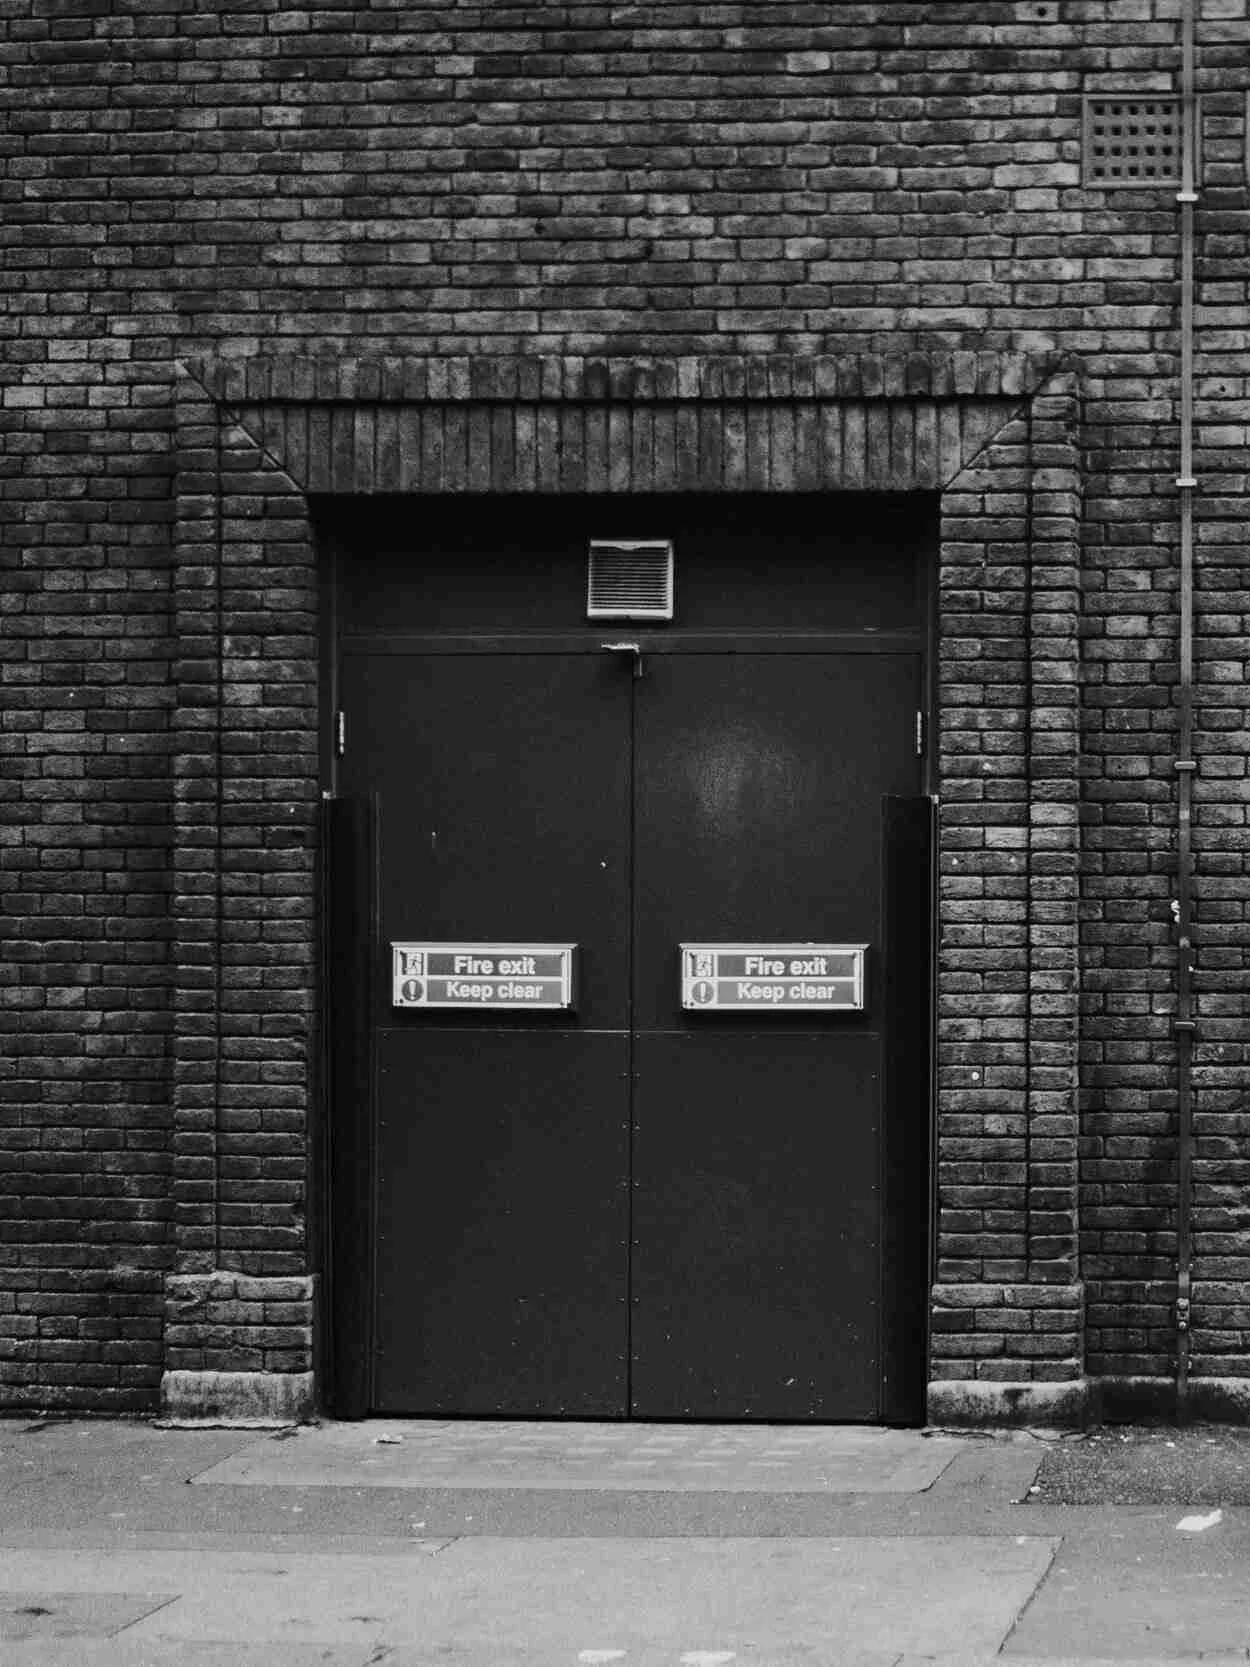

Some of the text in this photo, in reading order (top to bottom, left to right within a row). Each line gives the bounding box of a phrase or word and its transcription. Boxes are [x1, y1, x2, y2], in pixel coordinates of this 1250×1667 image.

[454, 955, 536, 975] Fire exit
[745, 957, 828, 976] Fire exit
[447, 981, 543, 1001] Keep clear
[737, 982, 836, 1003] Keep clear
